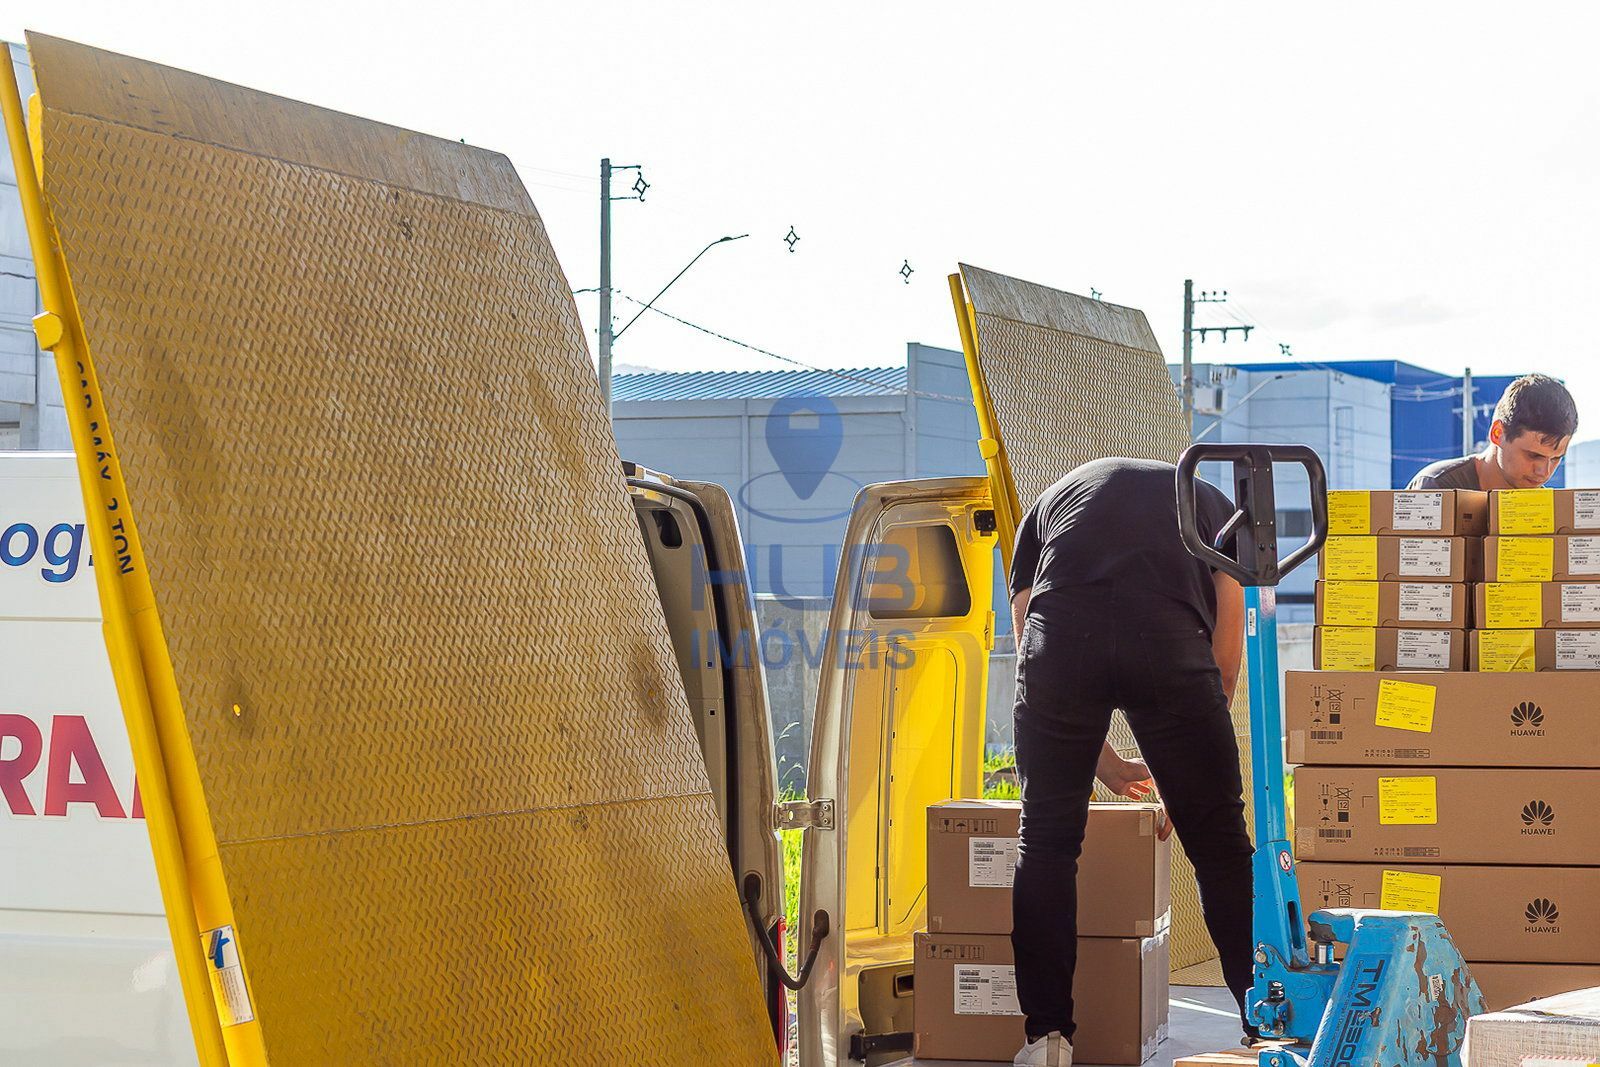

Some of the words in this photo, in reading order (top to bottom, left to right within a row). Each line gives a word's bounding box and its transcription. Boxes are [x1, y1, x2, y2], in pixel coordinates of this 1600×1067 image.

[111, 518, 134, 575] TON
[1510, 729, 1545, 737] HUAWEI
[0, 714, 147, 819] RA
